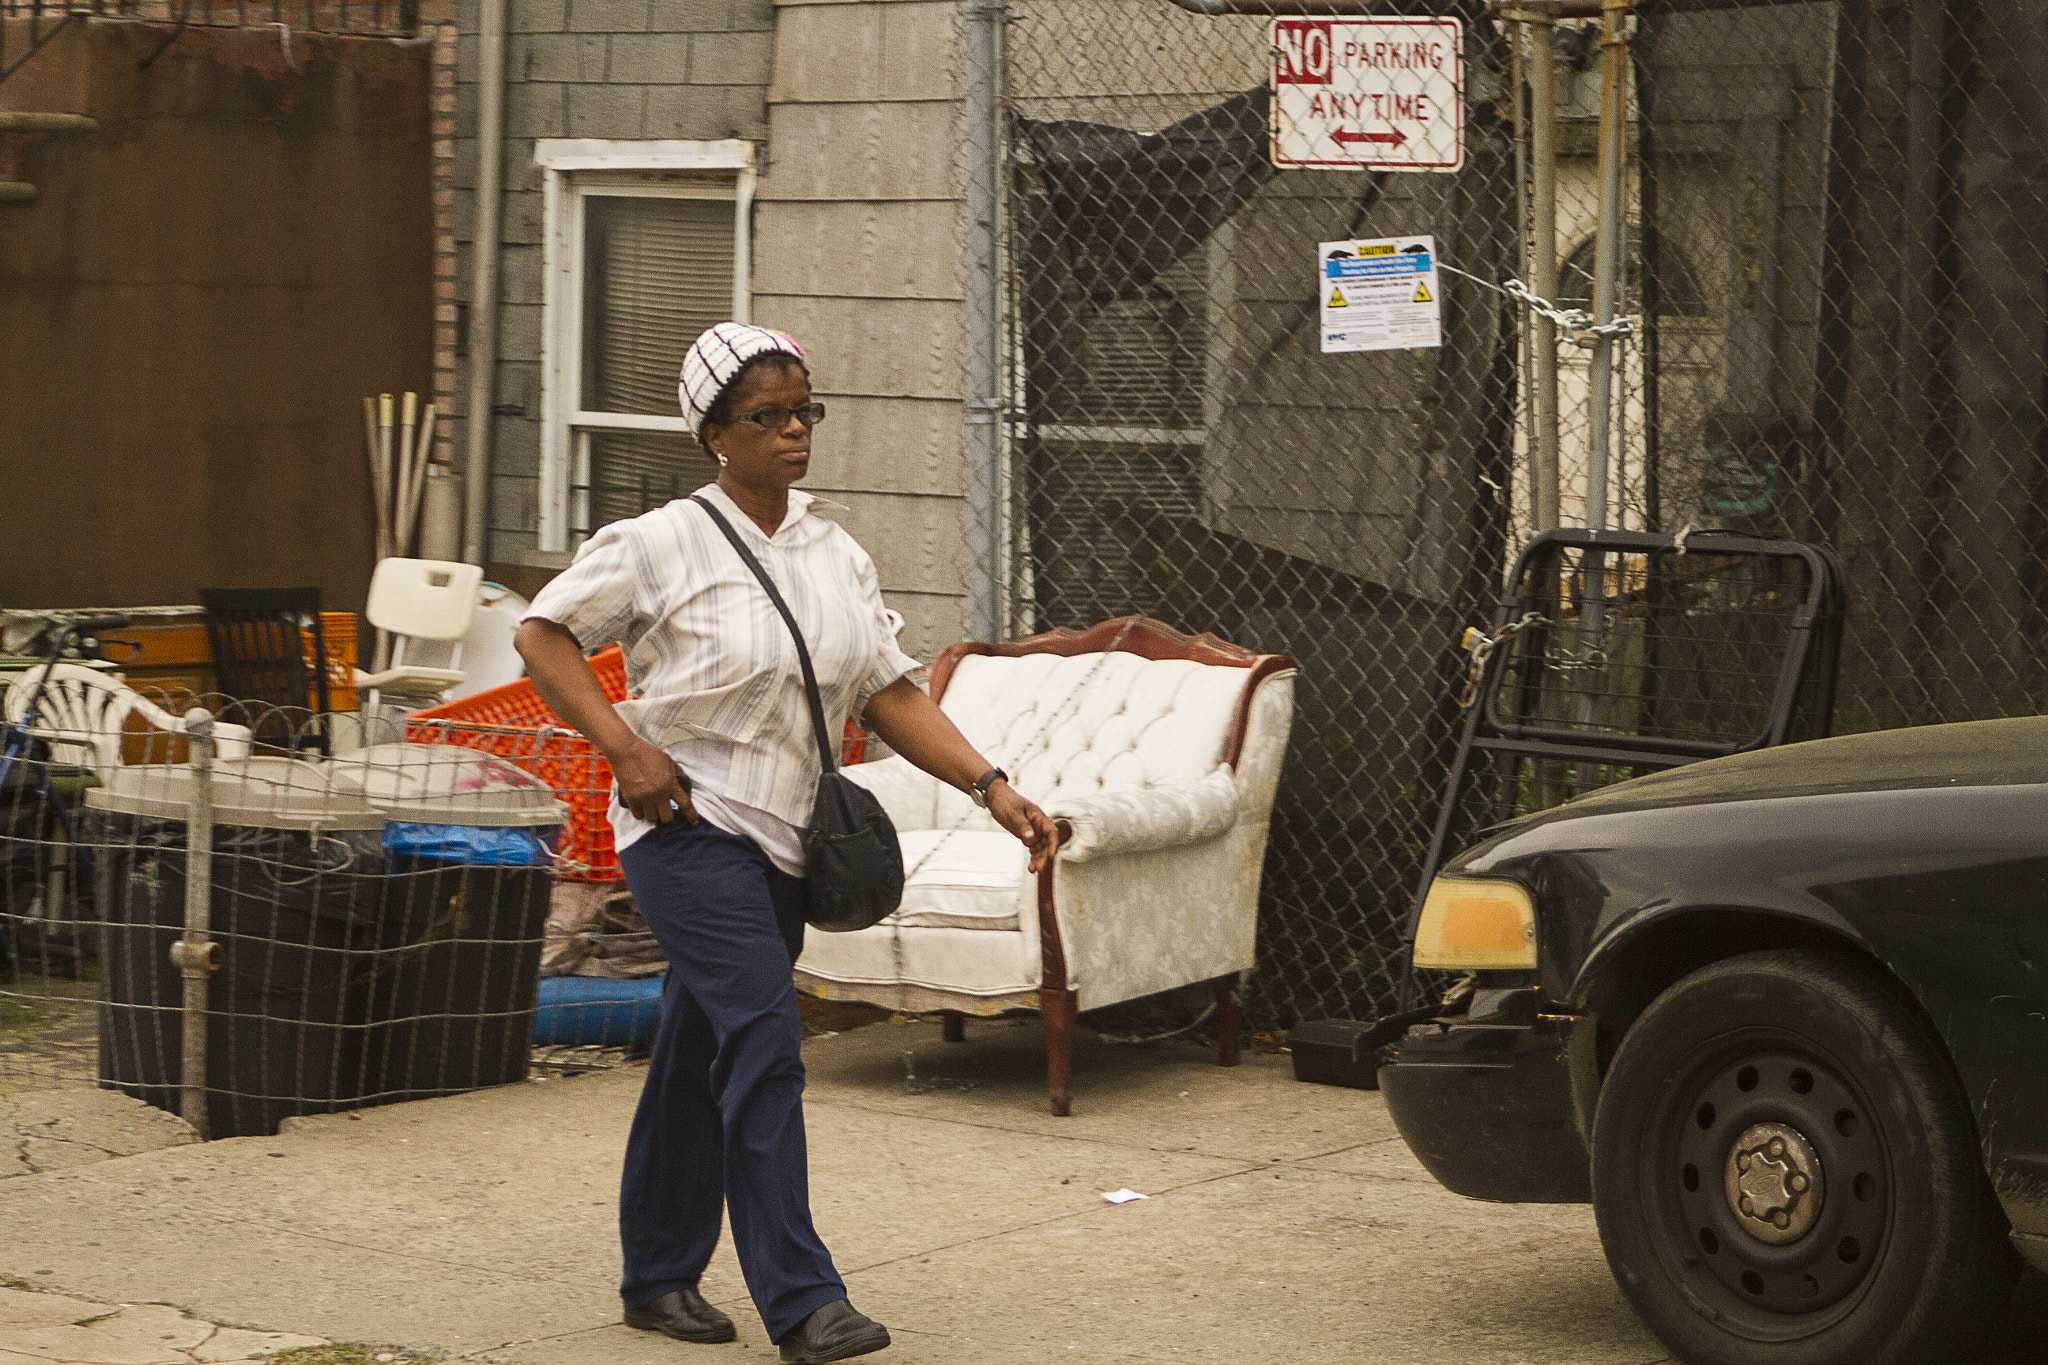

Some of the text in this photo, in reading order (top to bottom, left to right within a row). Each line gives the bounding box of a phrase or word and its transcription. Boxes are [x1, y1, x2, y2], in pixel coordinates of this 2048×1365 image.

[1278, 28, 1443, 77] NO PARKING
[1309, 93, 1430, 121] ANYTIME
